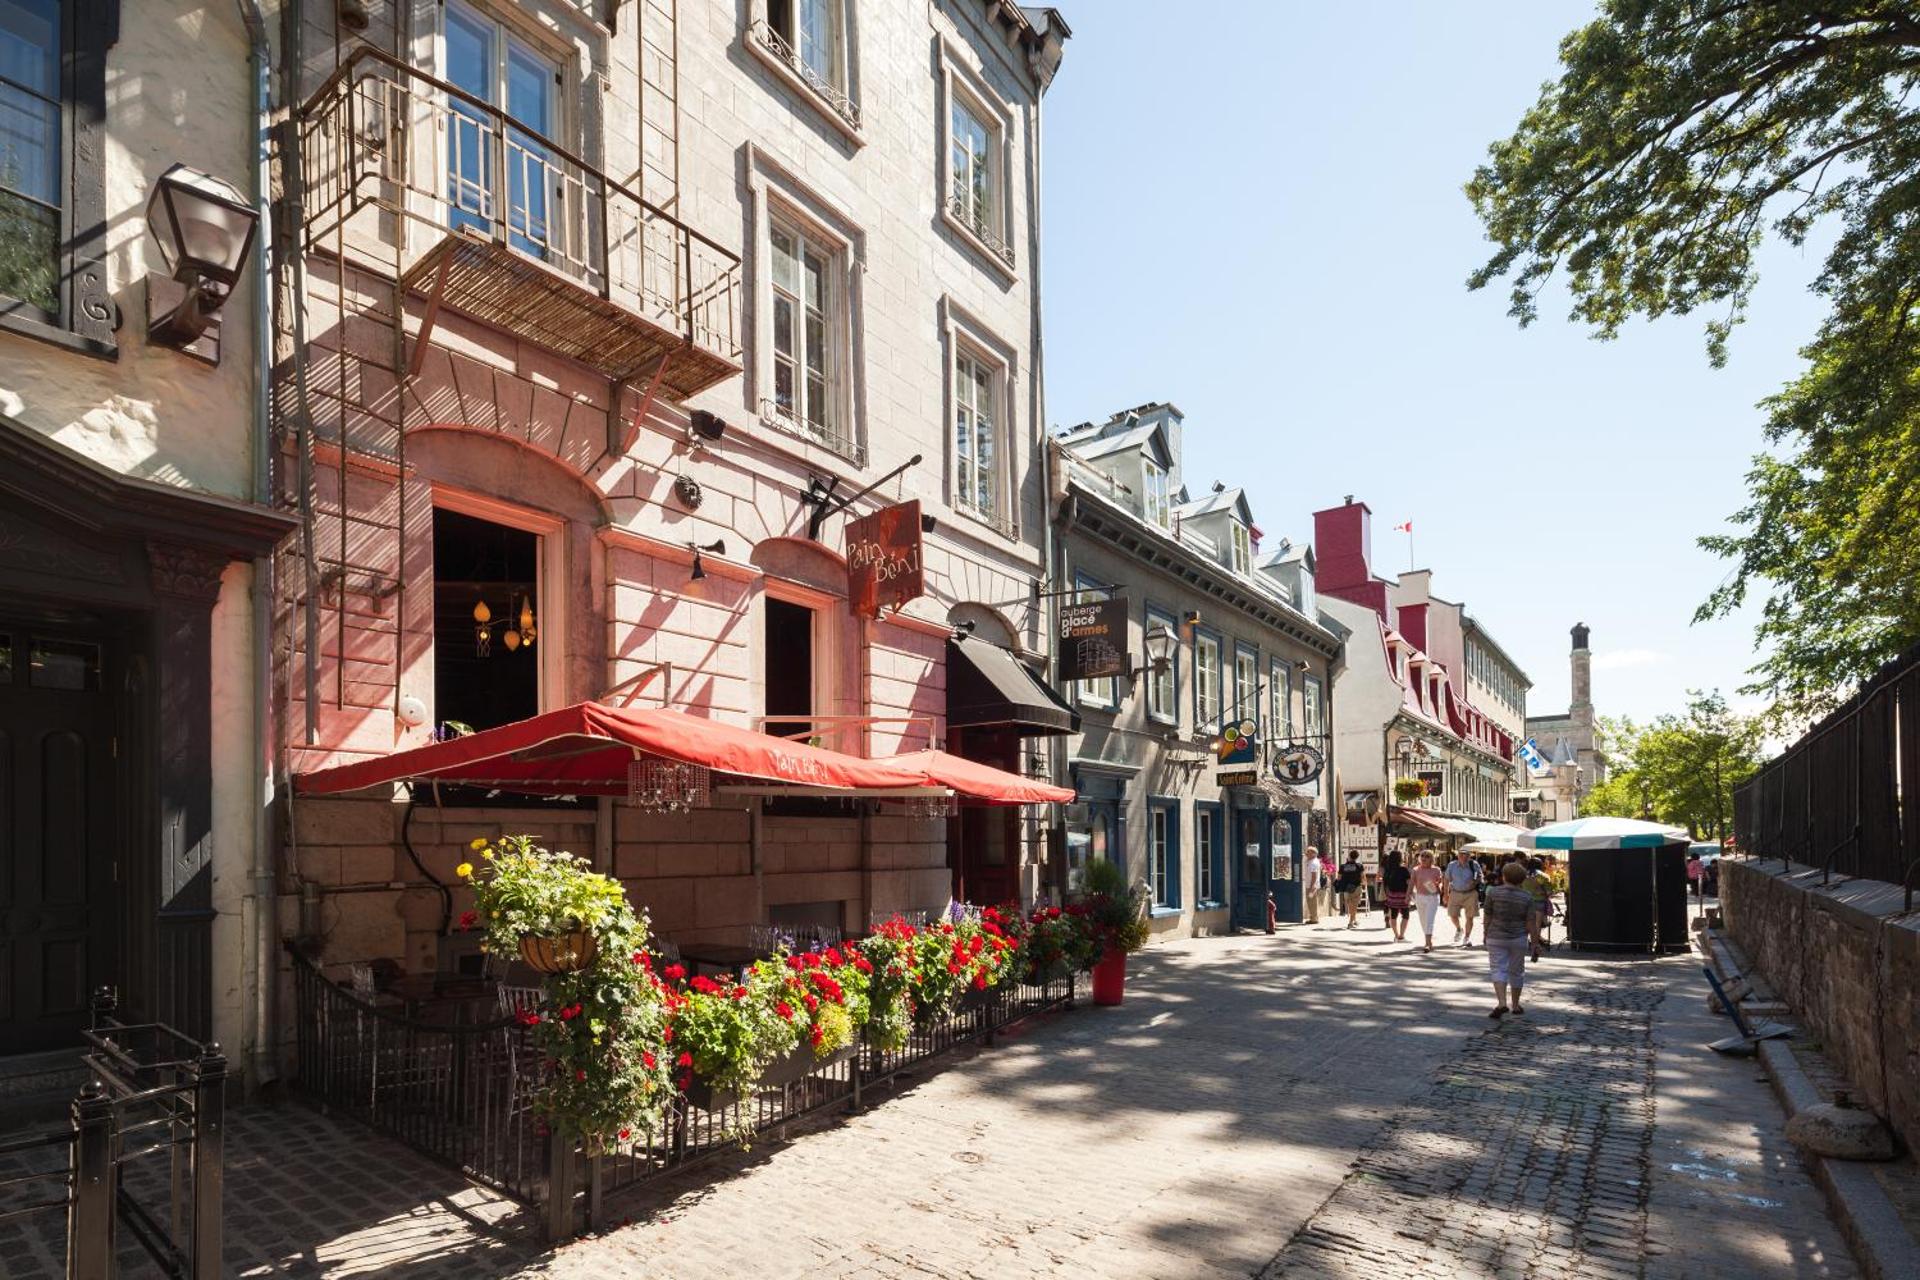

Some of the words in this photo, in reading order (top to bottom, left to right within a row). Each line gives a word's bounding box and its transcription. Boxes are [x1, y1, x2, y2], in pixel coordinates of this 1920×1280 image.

[847, 539, 886, 576] Pain
[1061, 605, 1102, 618] auberge
[1061, 624, 1109, 639] d'armes
